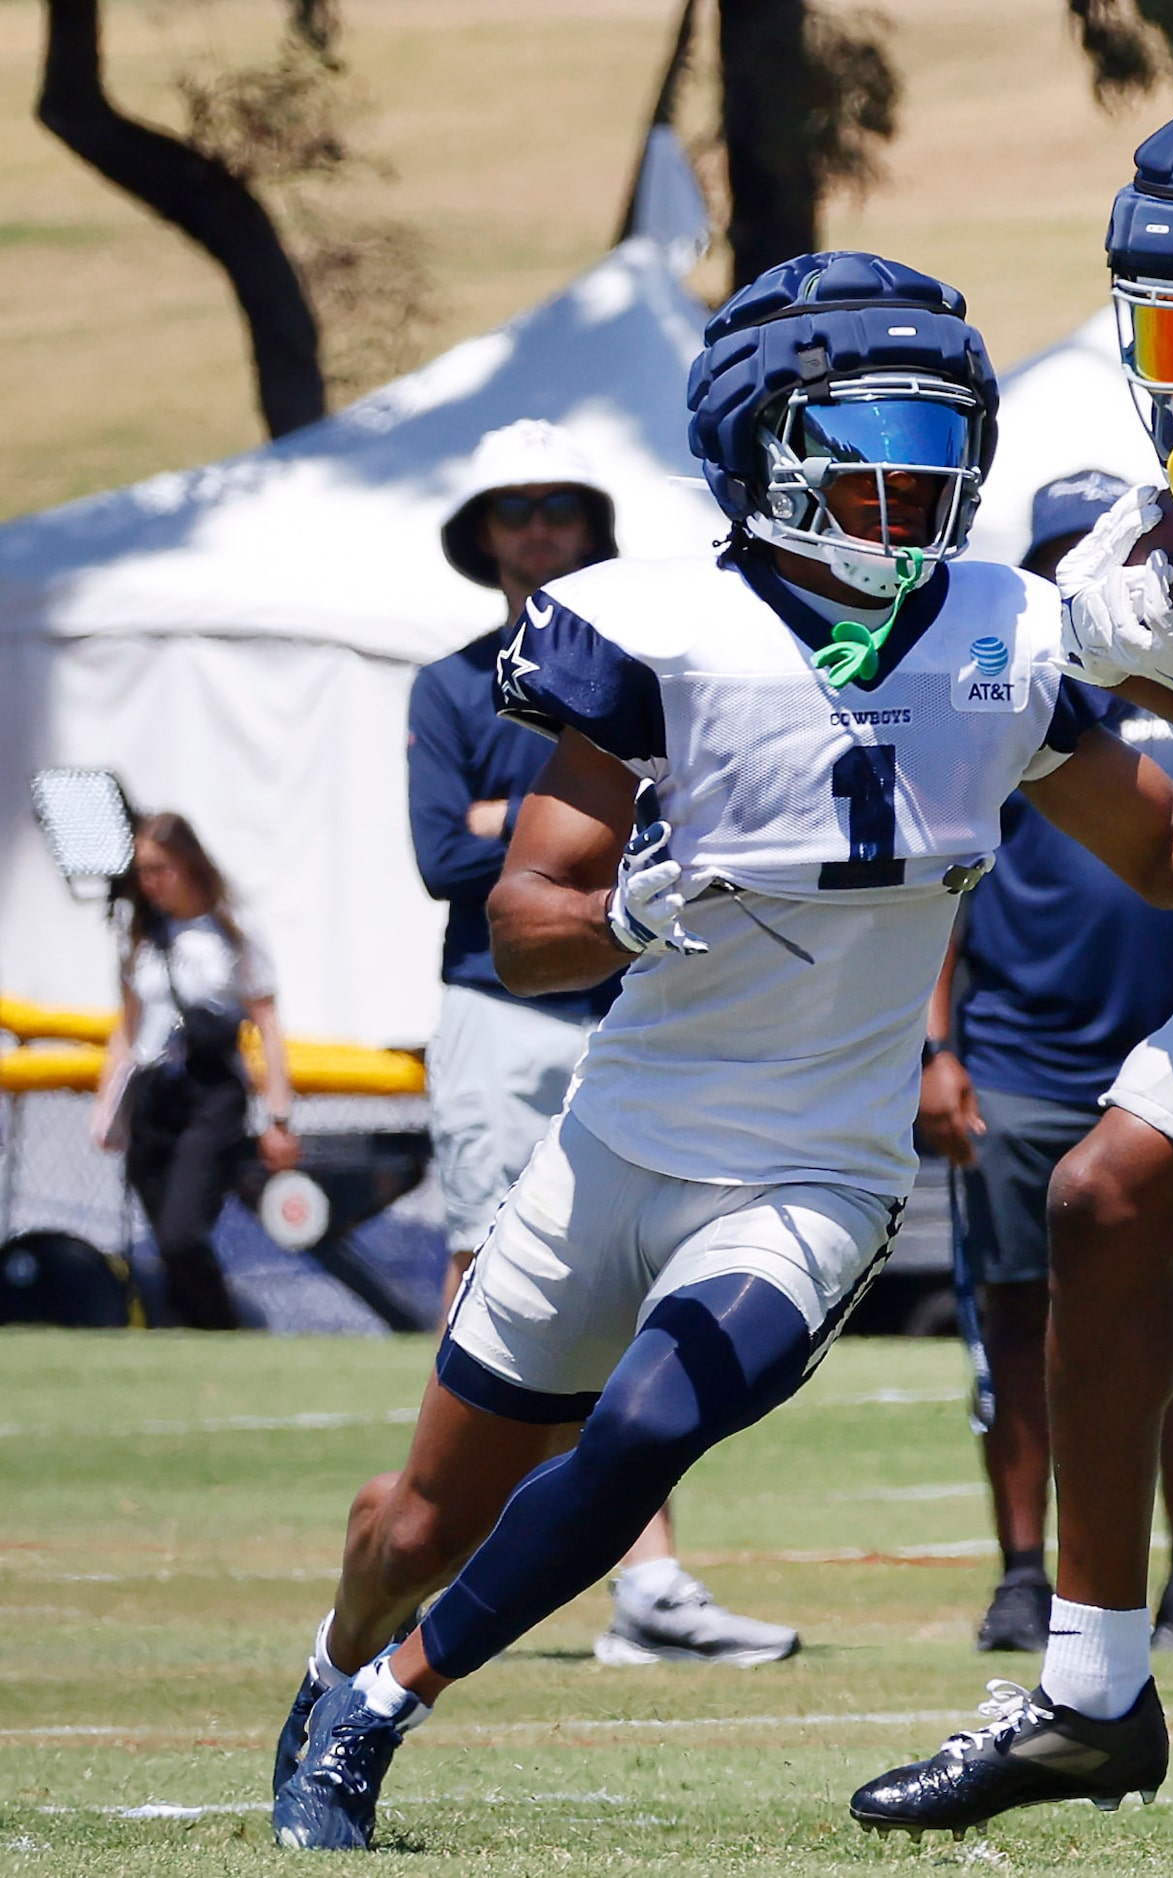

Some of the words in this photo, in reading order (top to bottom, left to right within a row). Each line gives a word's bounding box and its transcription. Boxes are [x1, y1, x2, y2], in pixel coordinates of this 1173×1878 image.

[968, 683, 1014, 701] AT&T
[830, 709, 911, 727] COWBOYS
[818, 744, 906, 889] 1
